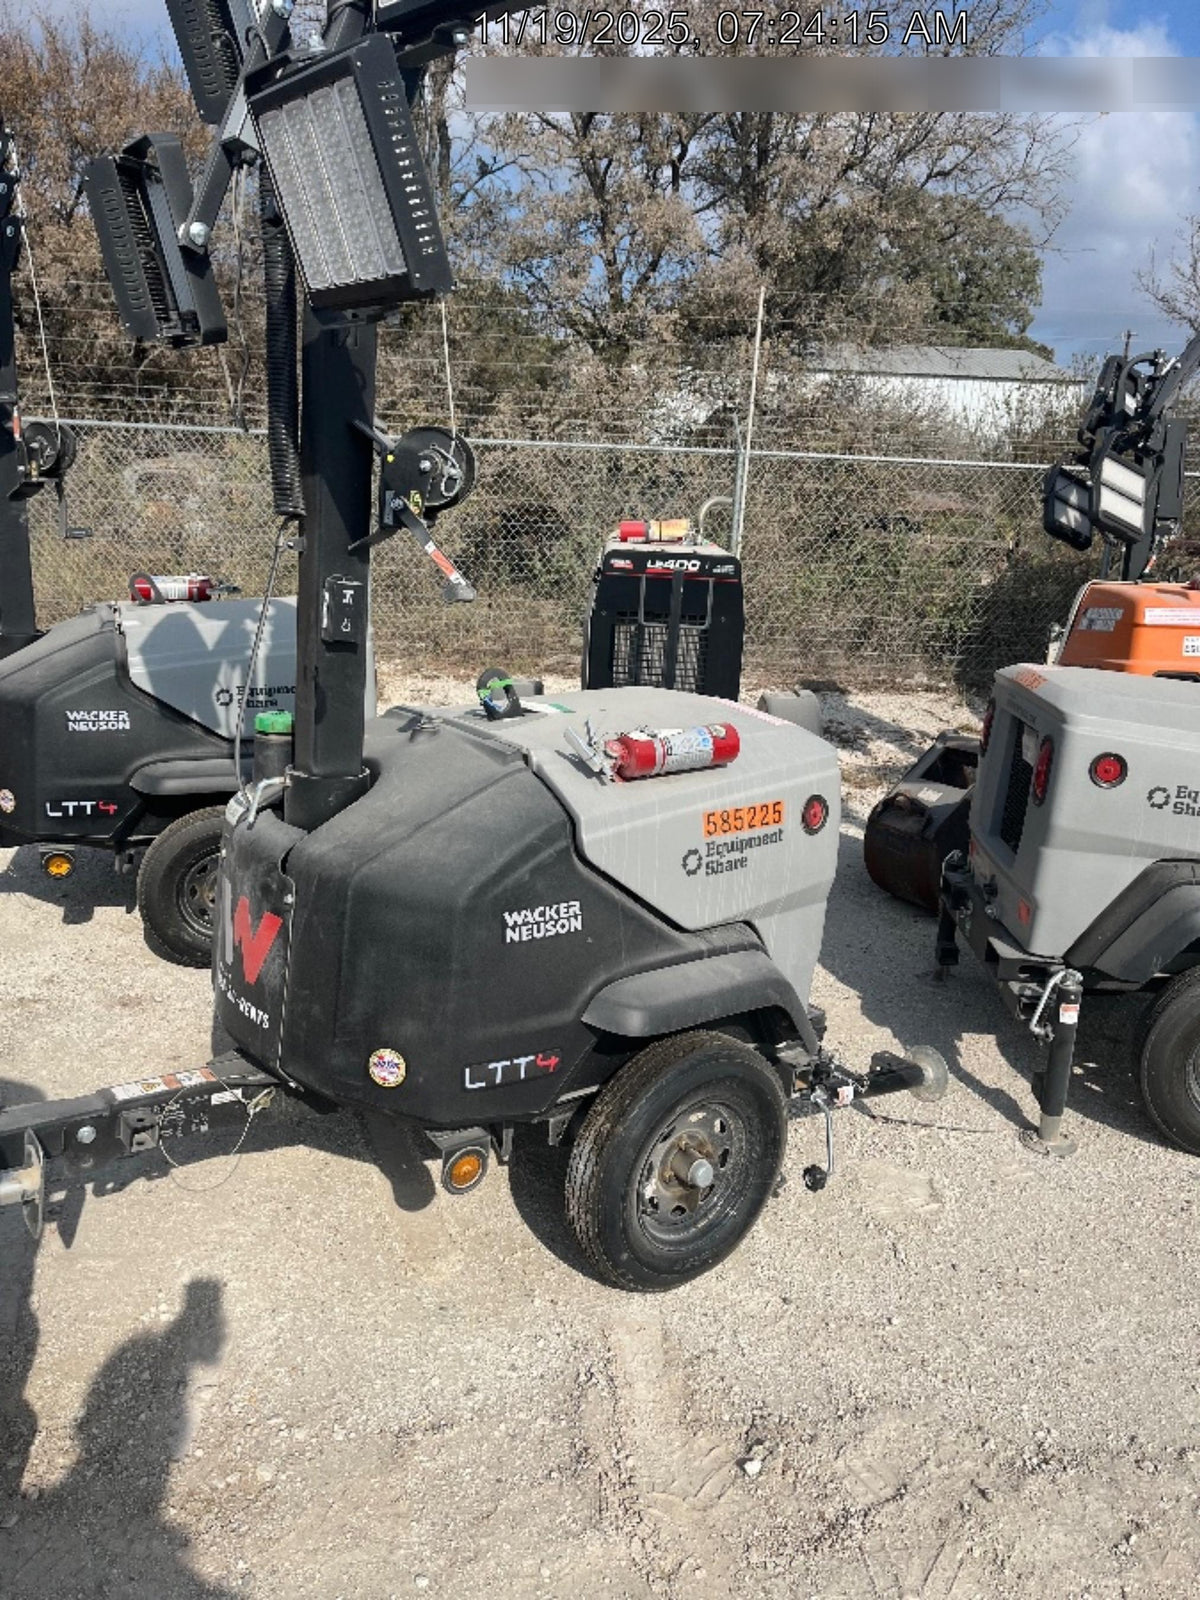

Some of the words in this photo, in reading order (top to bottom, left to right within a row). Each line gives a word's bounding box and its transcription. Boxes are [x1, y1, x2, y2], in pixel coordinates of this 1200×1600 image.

[65, 710, 129, 721] WACKER
[67, 721, 131, 732] NEUSON
[46, 800, 118, 817] LTT4
[706, 801, 782, 836] 585225
[705, 828, 784, 858] Equipment
[705, 857, 748, 877] Share
[502, 900, 582, 926] WACKER
[505, 915, 583, 943] NEUSON
[464, 1053, 560, 1089] LTT4
